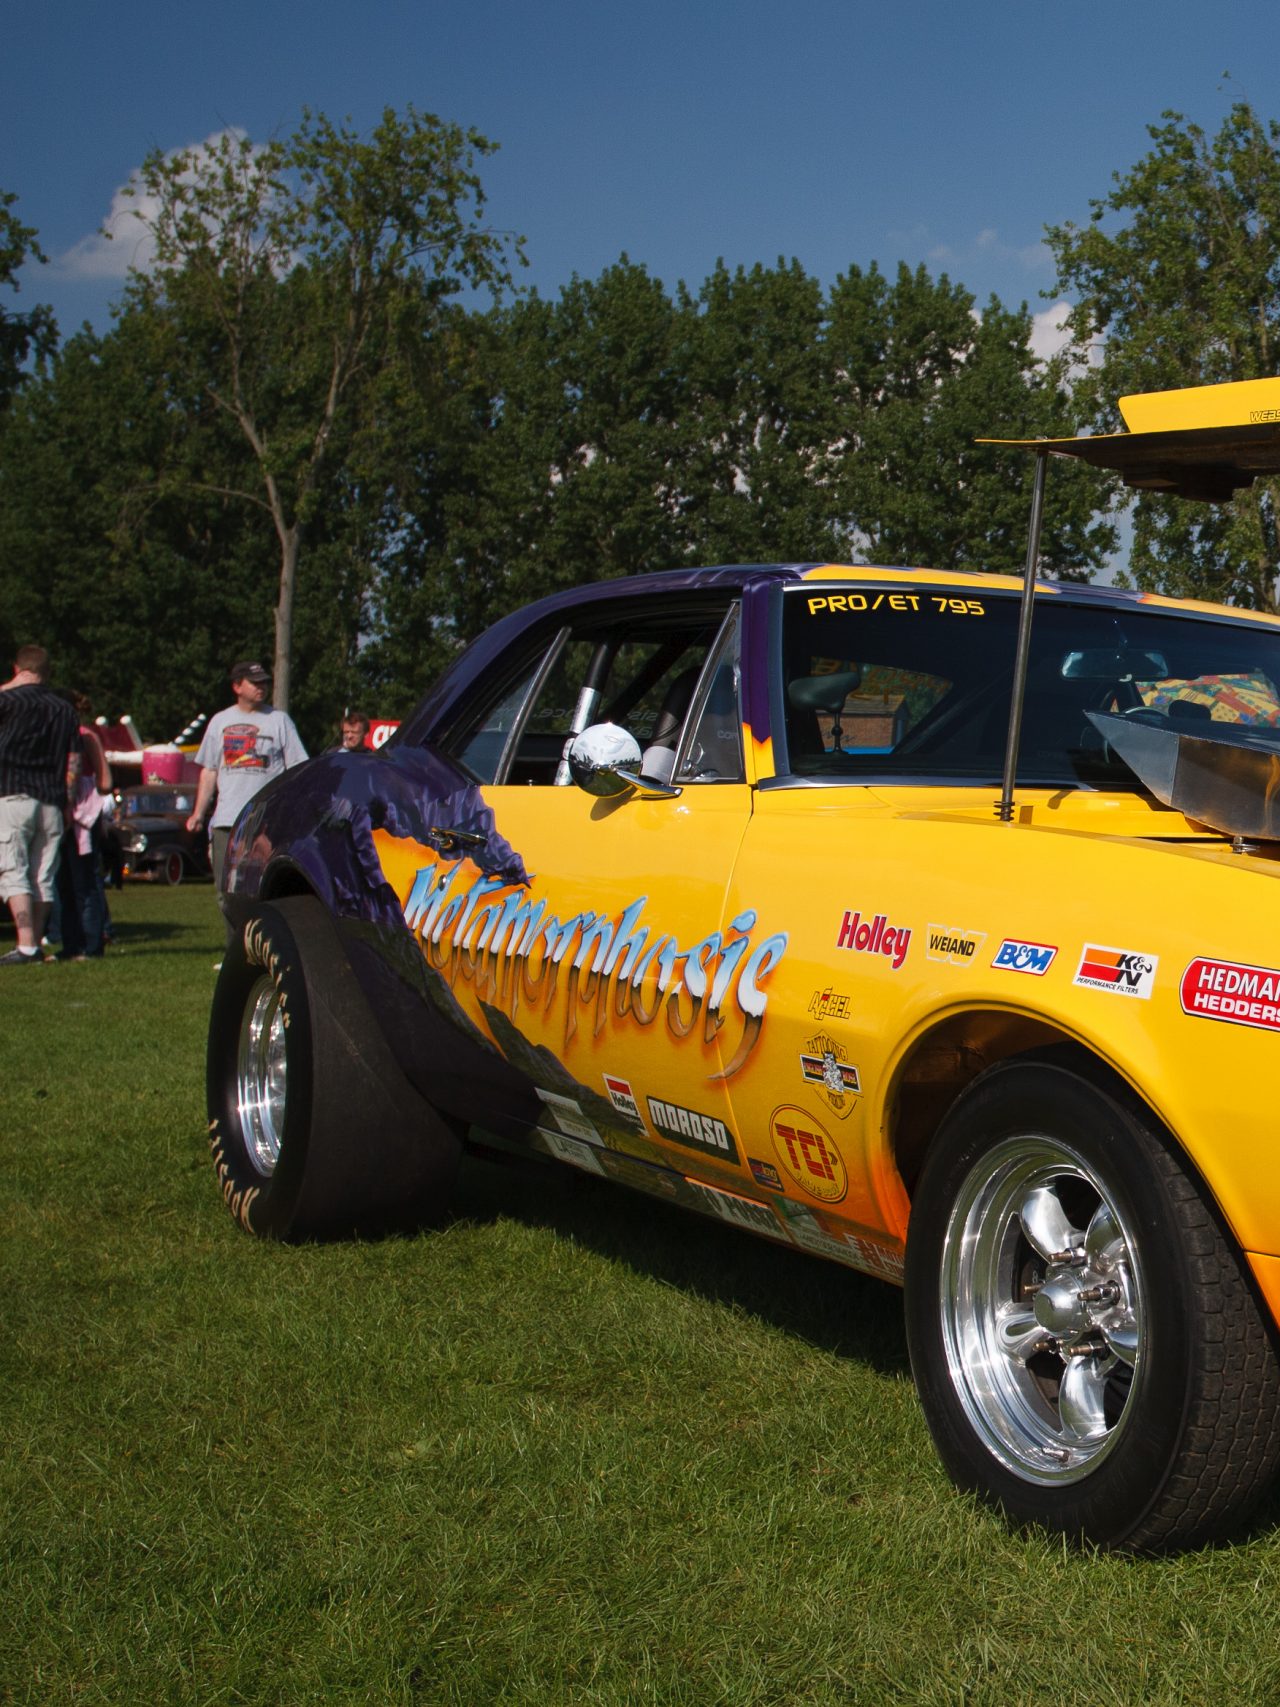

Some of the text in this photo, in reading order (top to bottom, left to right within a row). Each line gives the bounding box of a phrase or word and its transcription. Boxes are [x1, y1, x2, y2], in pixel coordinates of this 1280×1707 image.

[931, 597, 985, 616] 795
[837, 910, 912, 970] Holley
[929, 933, 976, 958] WEIAND
[998, 942, 1054, 973] B&M
[1076, 976, 1139, 995] PERFORMANCE FILTERS
[647, 1098, 730, 1151] MOROSO
[774, 1122, 836, 1182] TCI
